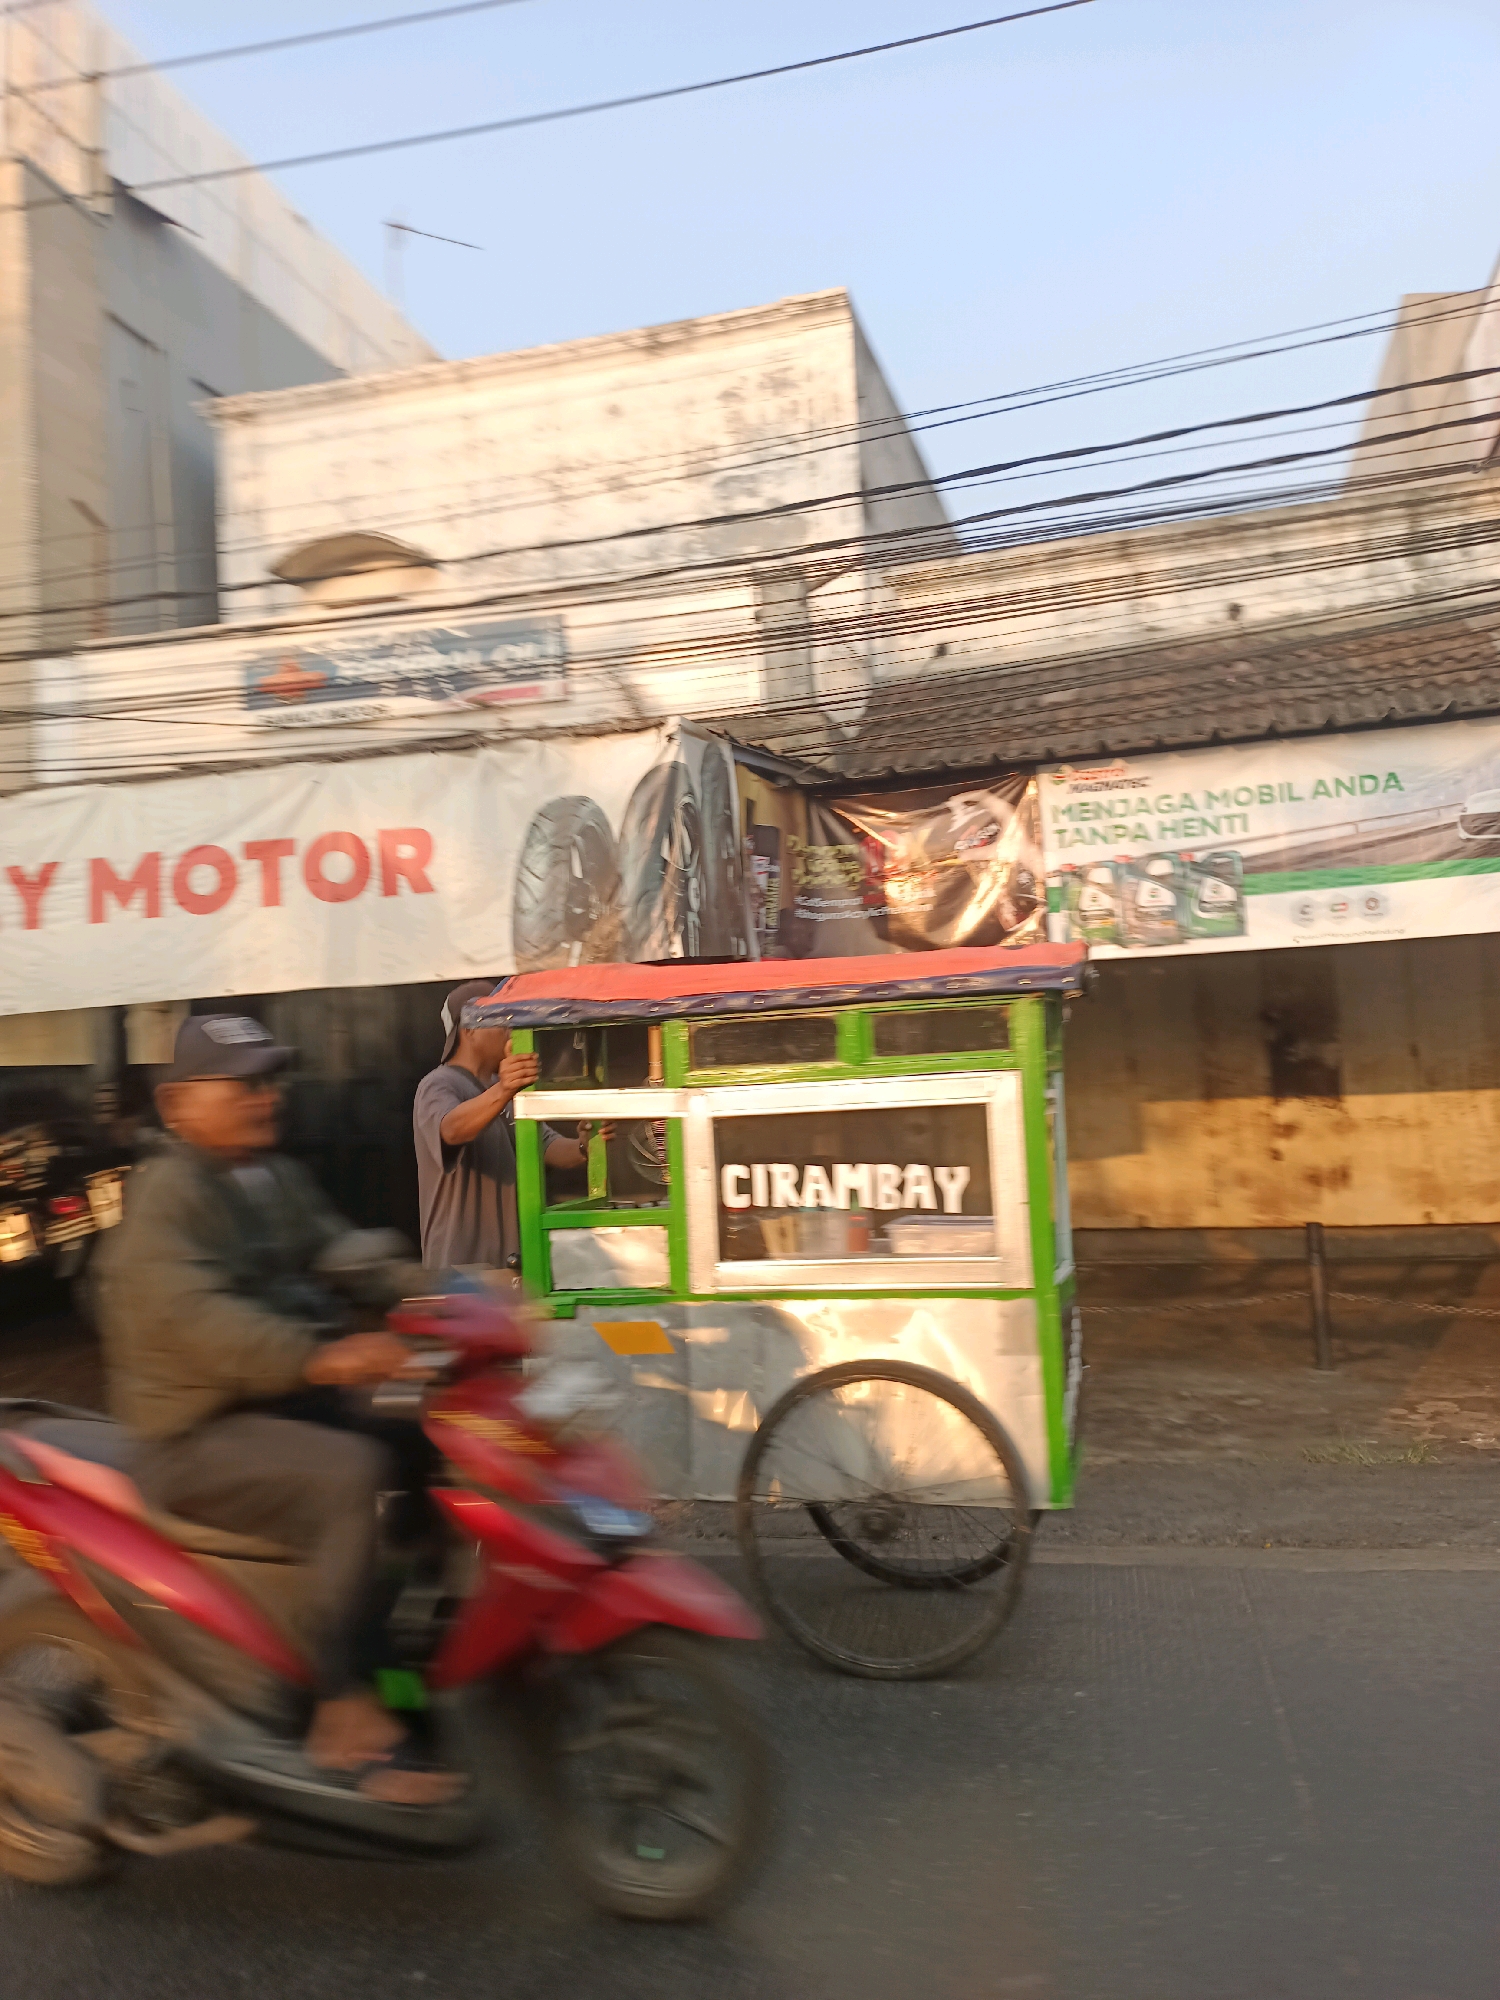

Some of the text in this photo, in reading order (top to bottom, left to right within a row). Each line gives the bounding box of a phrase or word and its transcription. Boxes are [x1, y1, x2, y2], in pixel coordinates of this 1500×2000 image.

[1050, 772, 1405, 823] MENJAGA MOBIL ANDA
[1053, 813, 1250, 849] TANPA HENTI
[87, 827, 436, 924] MOTOR
[720, 1162, 971, 1214] CIRAMBAY
